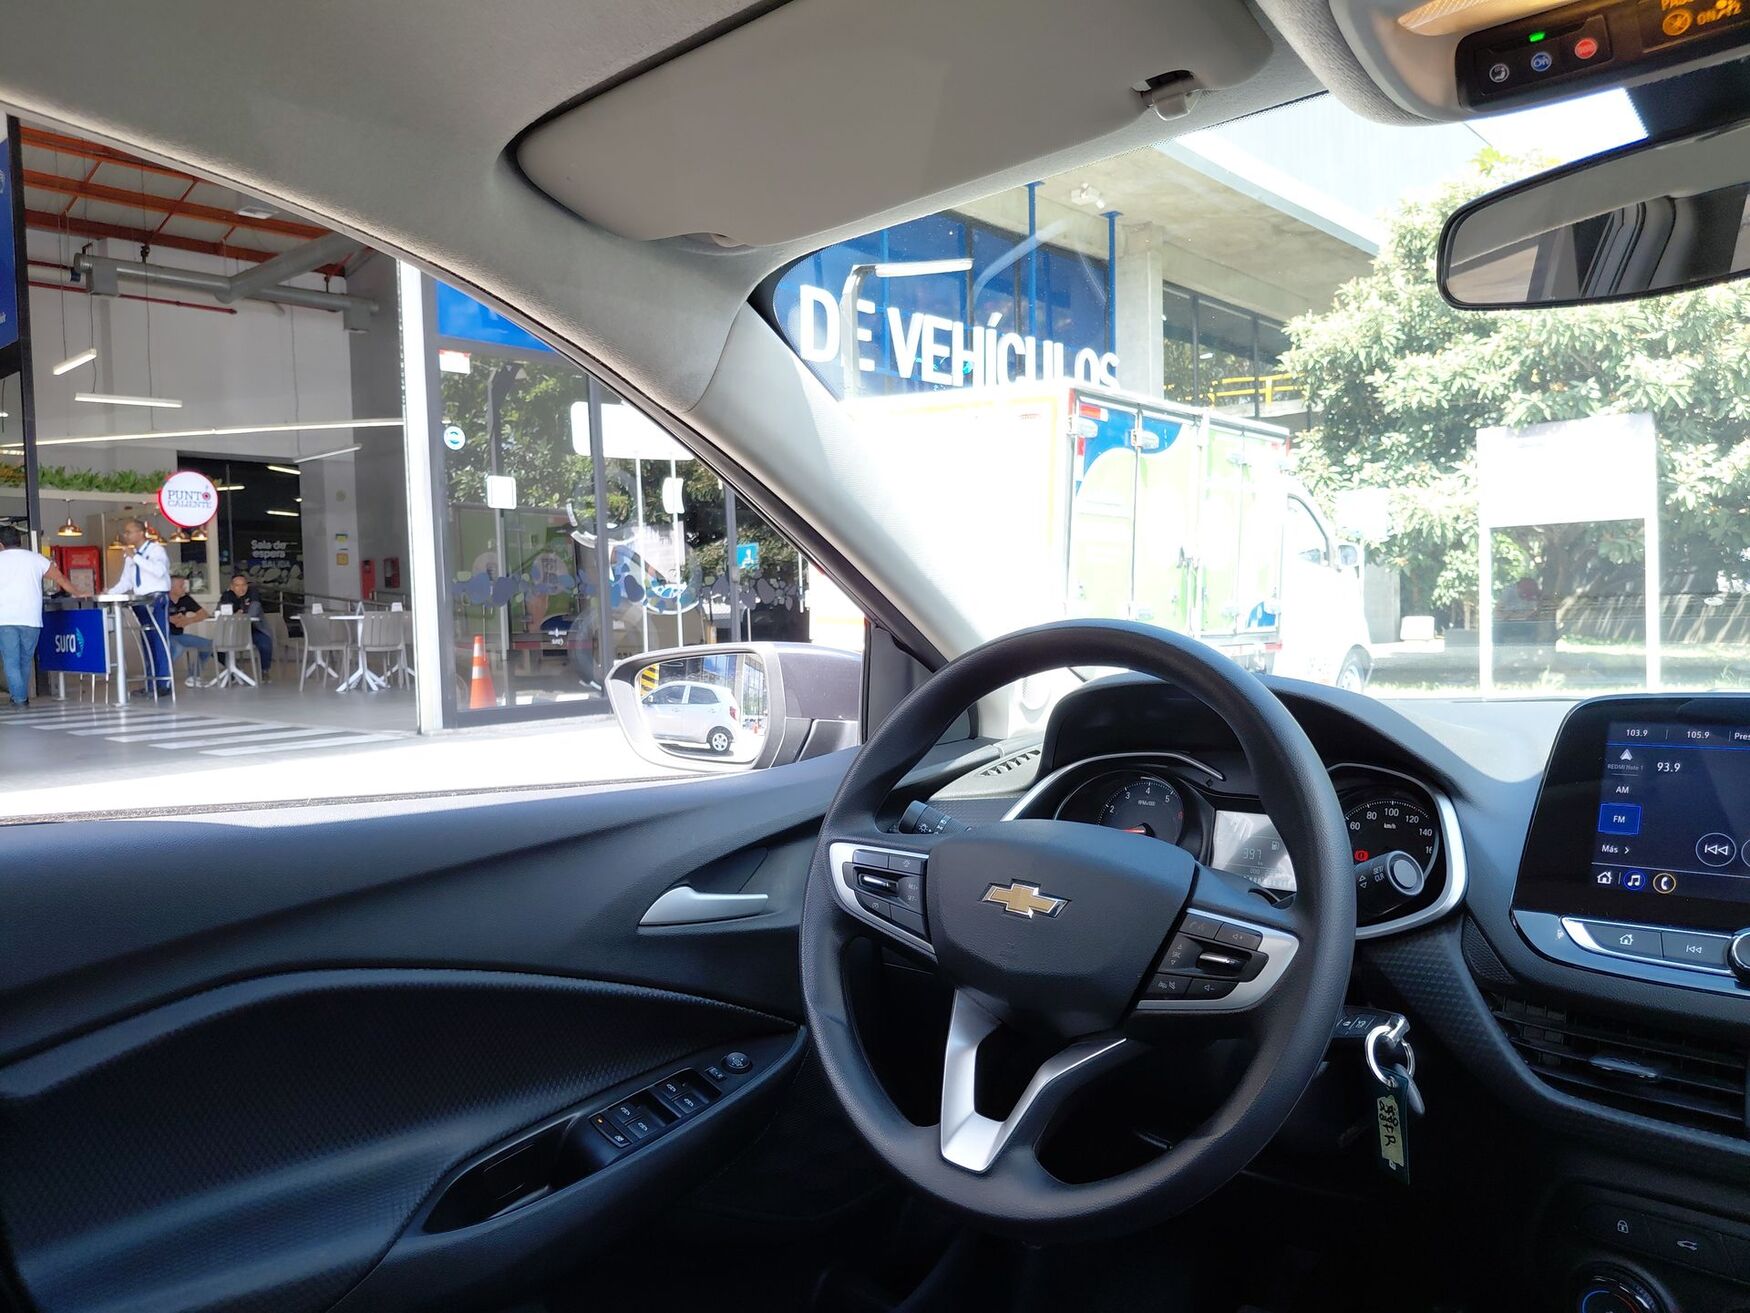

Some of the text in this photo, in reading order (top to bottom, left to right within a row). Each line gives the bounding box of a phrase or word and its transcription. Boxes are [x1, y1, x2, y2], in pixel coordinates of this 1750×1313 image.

[799, 284, 876, 372] DE
[54, 632, 77, 653] sura
[1625, 729, 1648, 737] 103.9
[1686, 731, 1710, 739] 105.9
[1656, 762, 1681, 773] 93.9
[1145, 786, 1151, 795] 4
[1615, 786, 1630, 794] AM
[1125, 791, 1131, 800] 3
[1164, 795, 1171, 803] 5
[1109, 805, 1115, 814] 2
[1384, 807, 1399, 817] 100
[1366, 811, 1378, 821] 80
[1405, 815, 1419, 824] 120
[1612, 815, 1626, 824] FM
[1349, 821, 1361, 831] 60
[1419, 828, 1433, 837] 140
[1601, 844, 1619, 854] Más
